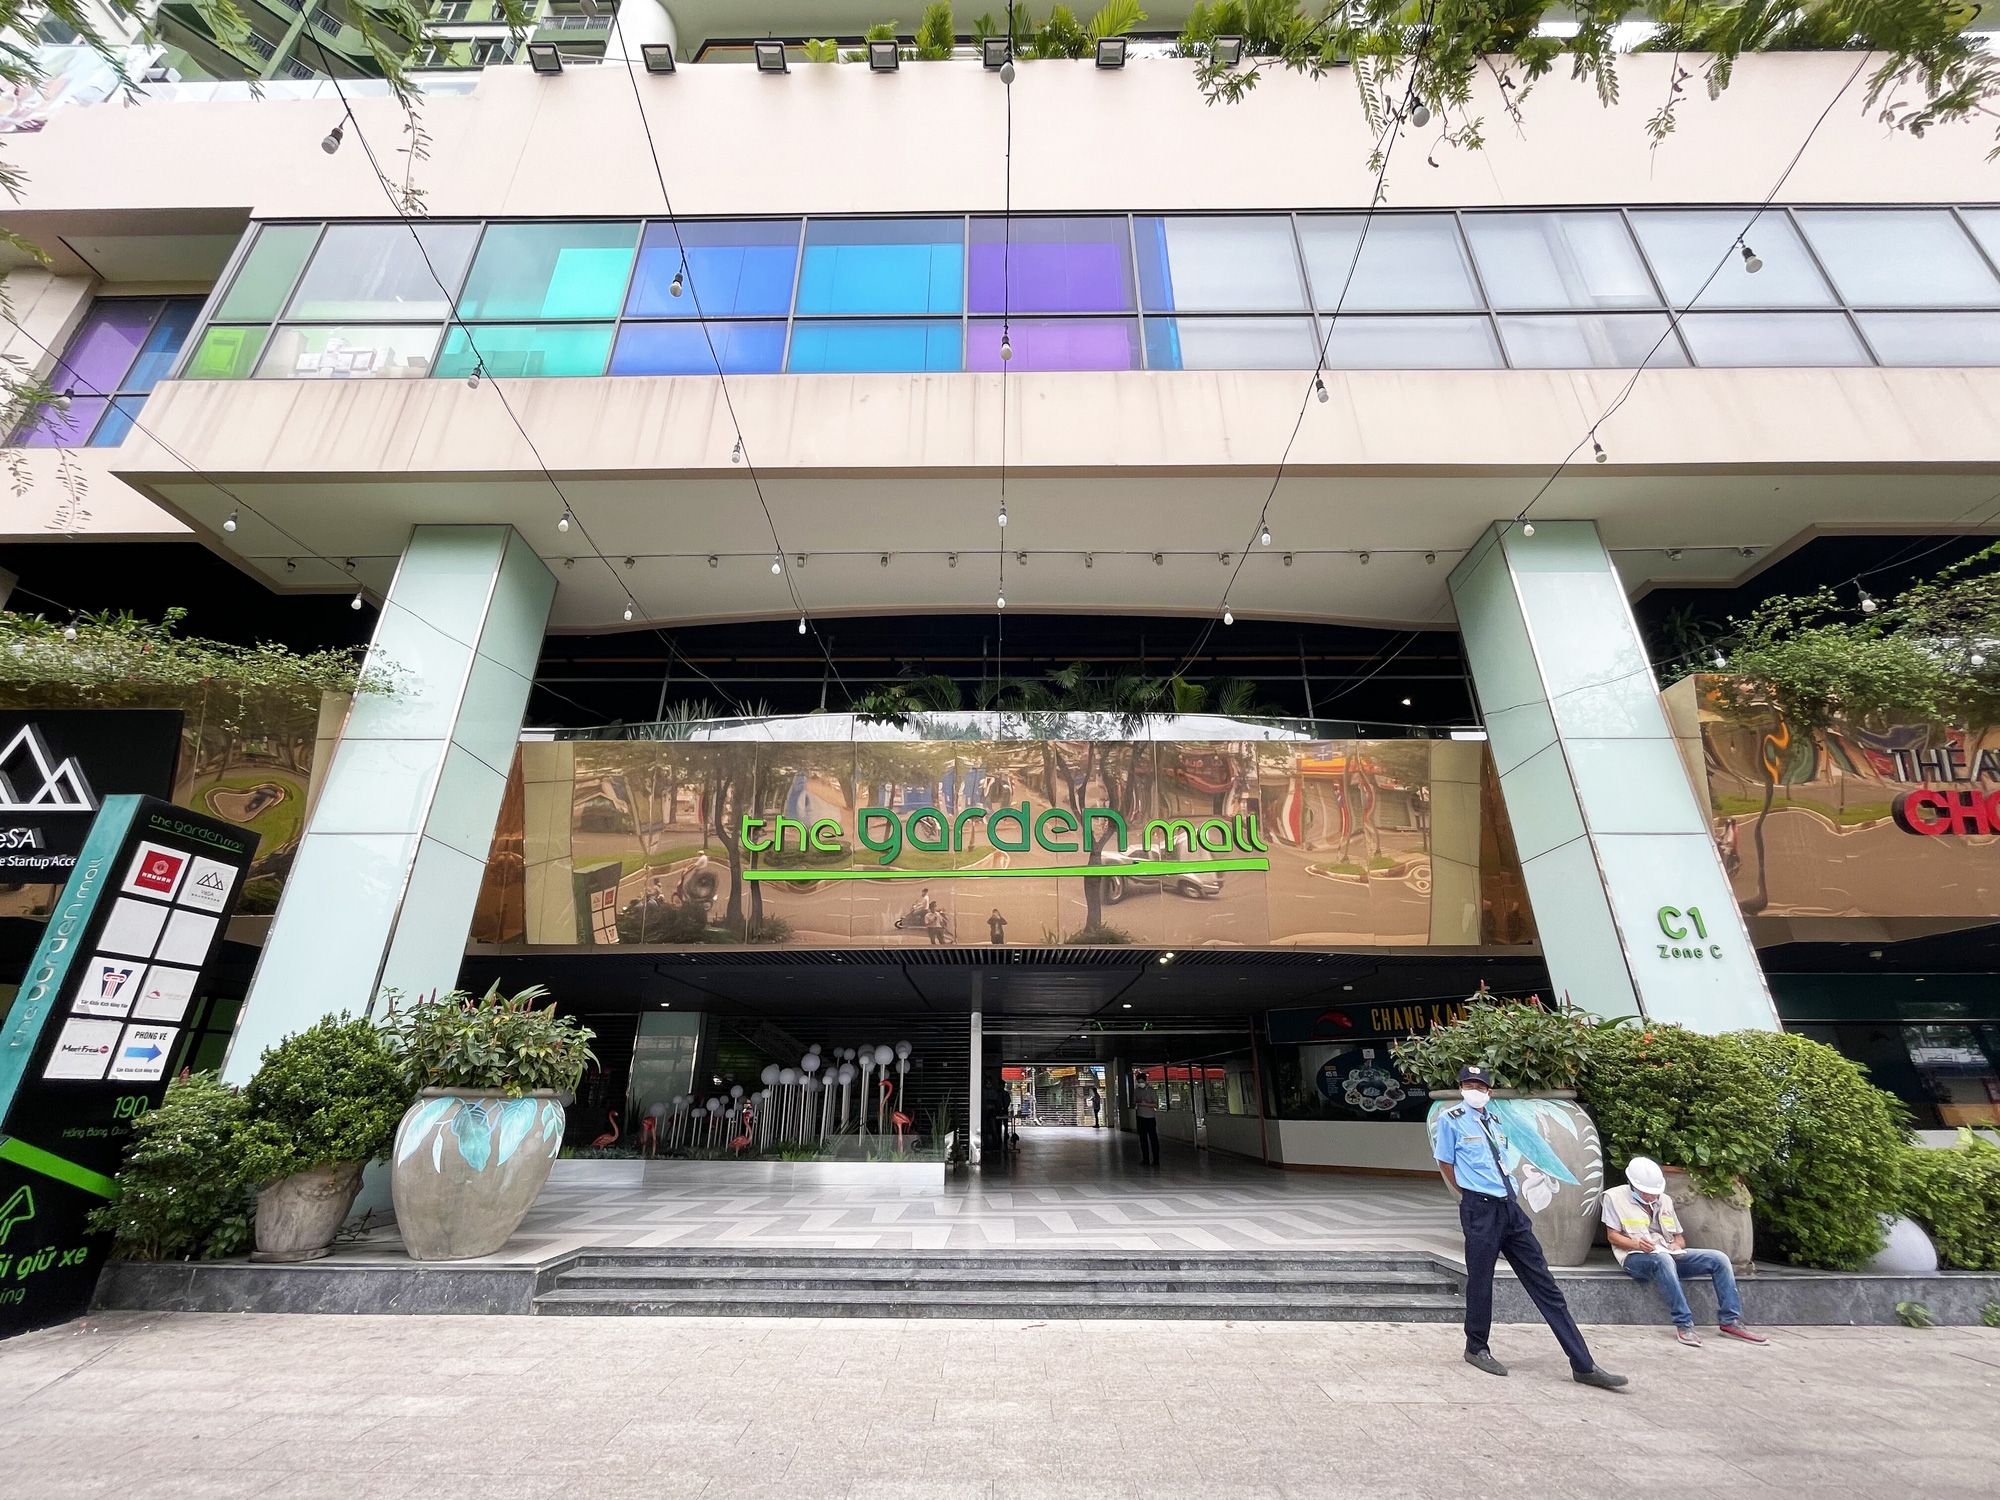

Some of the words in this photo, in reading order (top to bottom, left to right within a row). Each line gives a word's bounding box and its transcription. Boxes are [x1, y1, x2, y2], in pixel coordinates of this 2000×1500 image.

[150, 814, 172, 828] the
[174, 820, 223, 843] garden
[741, 813, 843, 852] the
[858, 800, 1128, 865] garden
[1143, 815, 1269, 853] mall
[7, 855, 49, 870] Startup
[1657, 905, 1708, 939] C1
[1657, 944, 1704, 959] Zone
[1709, 944, 1723, 960] C
[1370, 1005, 1426, 1031] CHANG
[113, 1096, 149, 1119] 190
[17, 1246, 57, 1281] giữ
[58, 1246, 88, 1267] xe
[0, 1287, 26, 1305] ing
